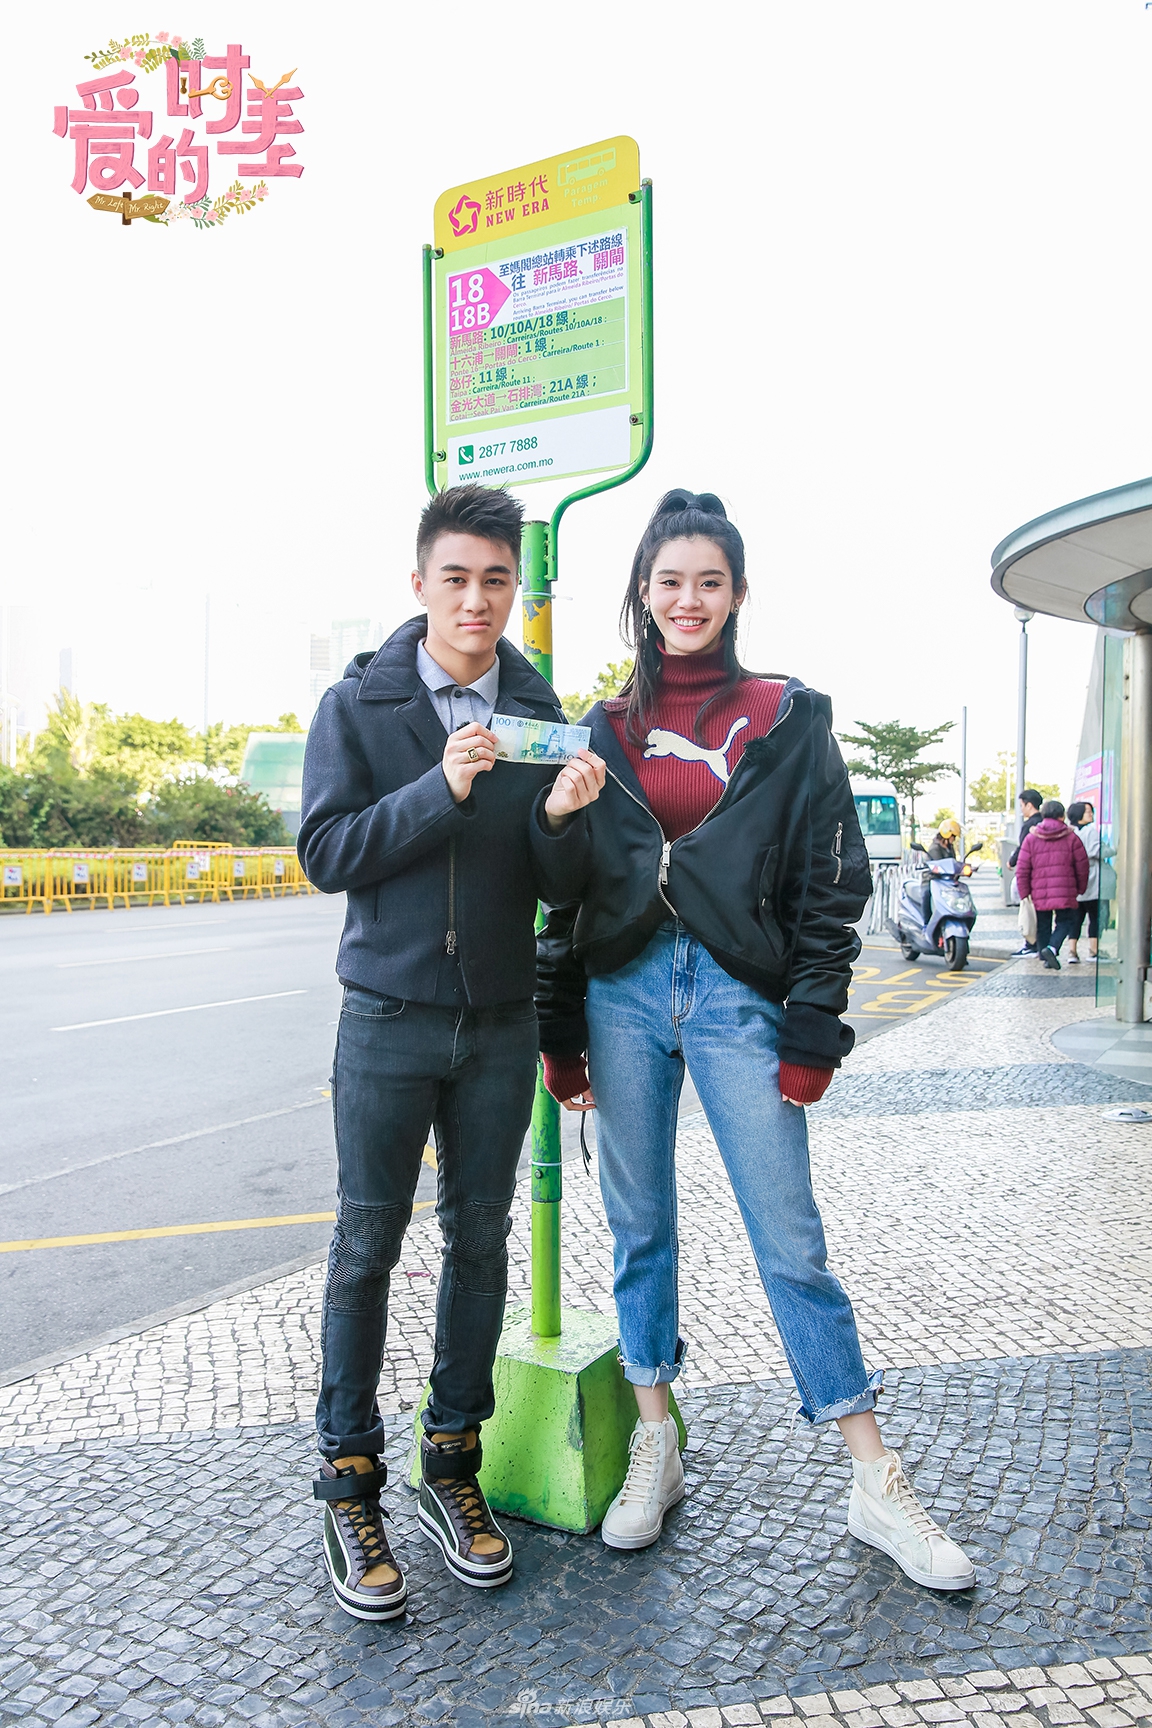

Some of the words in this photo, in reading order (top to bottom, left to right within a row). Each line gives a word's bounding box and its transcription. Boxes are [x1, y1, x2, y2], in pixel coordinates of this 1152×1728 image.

[485, 174, 549, 211] 新時代
[564, 178, 608, 198] Paragem
[571, 194, 601, 208] Temp.
[486, 207, 515, 228] NEW
[522, 198, 549, 217] ERA
[451, 273, 485, 308] 18
[511, 273, 526, 291] 往
[451, 302, 491, 331] 18B
[491, 314, 553, 340] 10/10A/18
[450, 346, 476, 356] Almeida
[478, 341, 502, 350] Ribeiro
[507, 327, 564, 343] Carreiras/Routes
[565, 316, 602, 331] 10/10A/18
[525, 341, 532, 353] 1
[450, 369, 469, 377] Ponte
[484, 361, 506, 370] Portas
[518, 354, 537, 363] Cerco
[542, 342, 594, 358] Carreira/Route
[595, 339, 599, 347] 1
[472, 379, 521, 394] Carreira/Route
[522, 376, 530, 384] 11
[479, 370, 492, 384] 11
[549, 378, 573, 393] 21A
[520, 393, 569, 408] Carreira/Route
[571, 390, 585, 399] 21A
[478, 442, 506, 459] 2877
[509, 436, 538, 452] 7888
[458, 457, 553, 481] www.newera.com.mo
[495, 717, 511, 727] 100
